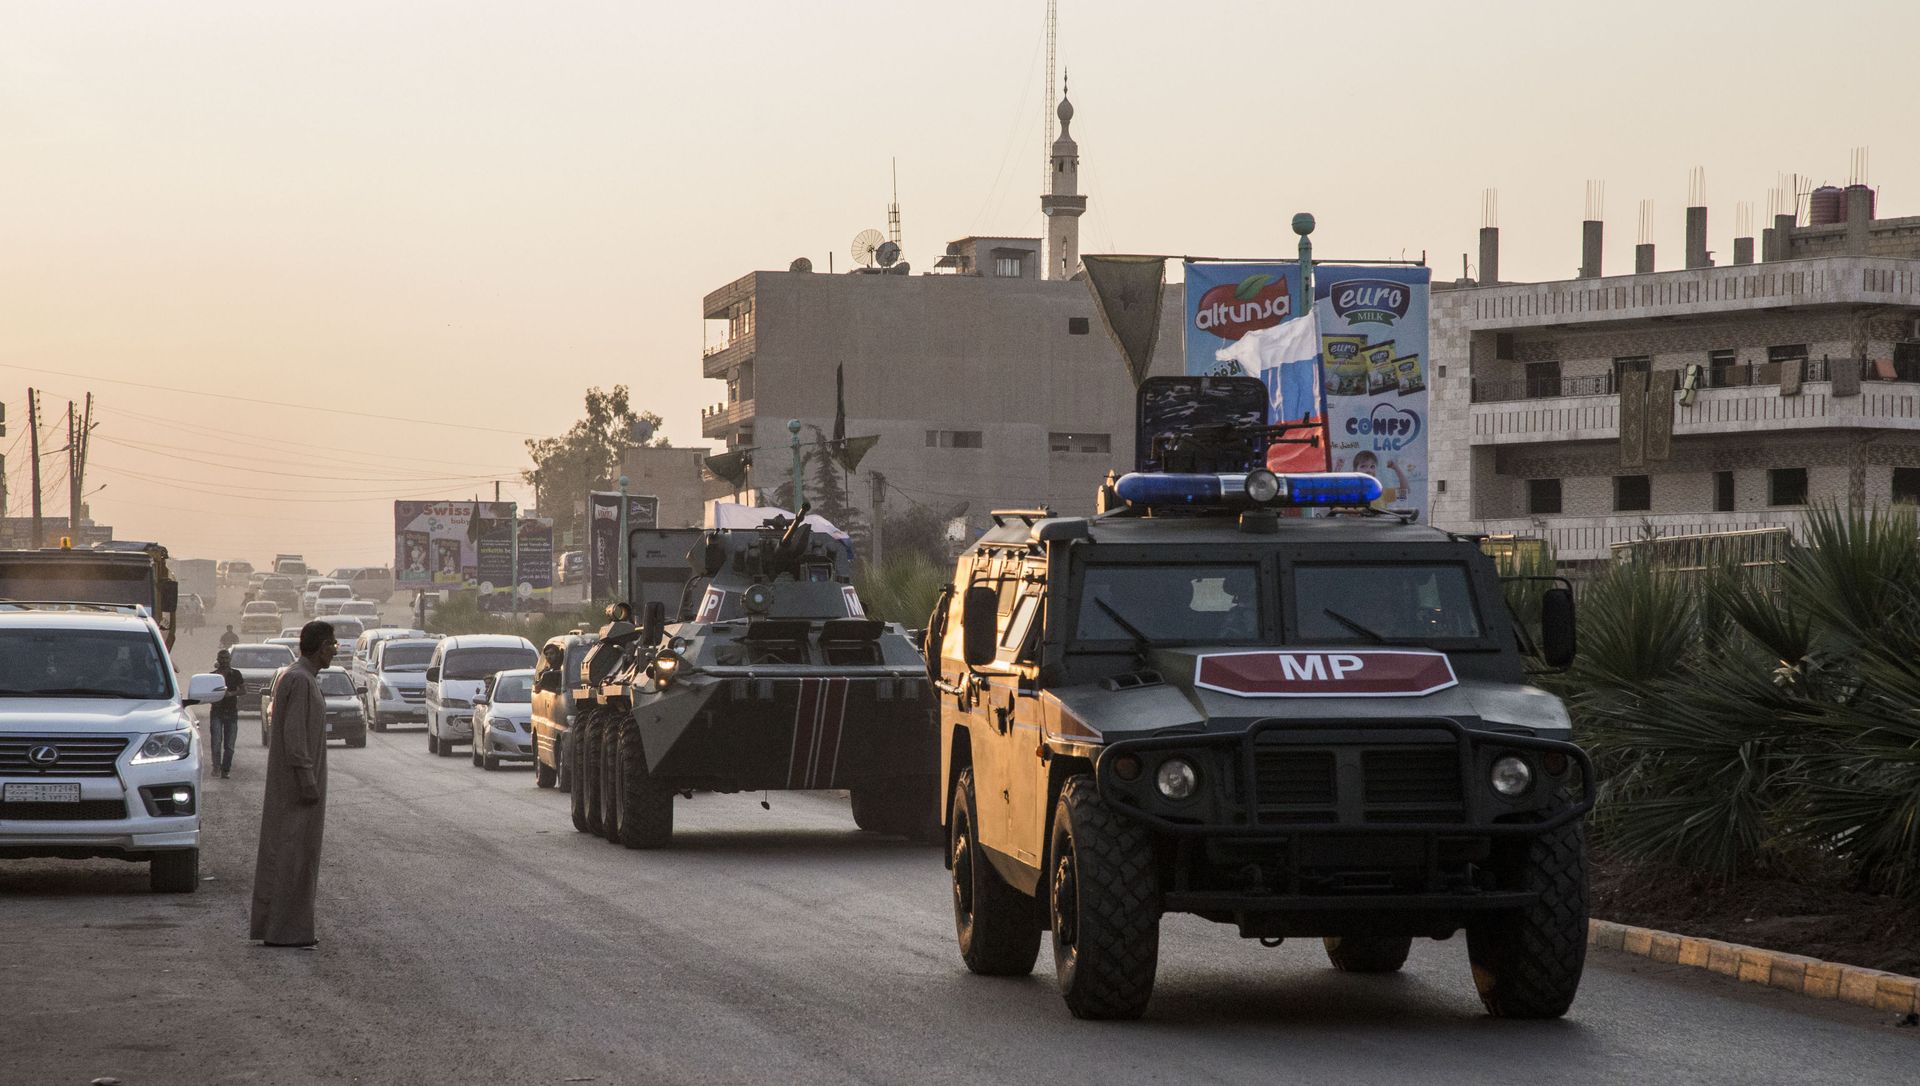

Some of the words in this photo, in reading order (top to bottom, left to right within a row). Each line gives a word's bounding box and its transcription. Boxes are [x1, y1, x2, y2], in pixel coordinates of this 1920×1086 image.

[1339, 287, 1402, 308] euro
[1195, 295, 1290, 330] altunsa
[1357, 312, 1384, 322] MILK
[1330, 344, 1357, 353] euro
[1345, 417, 1411, 436] CONFY
[1373, 438, 1402, 451] LAC
[423, 503, 471, 516] Swiss
[1278, 654, 1364, 681] MP
